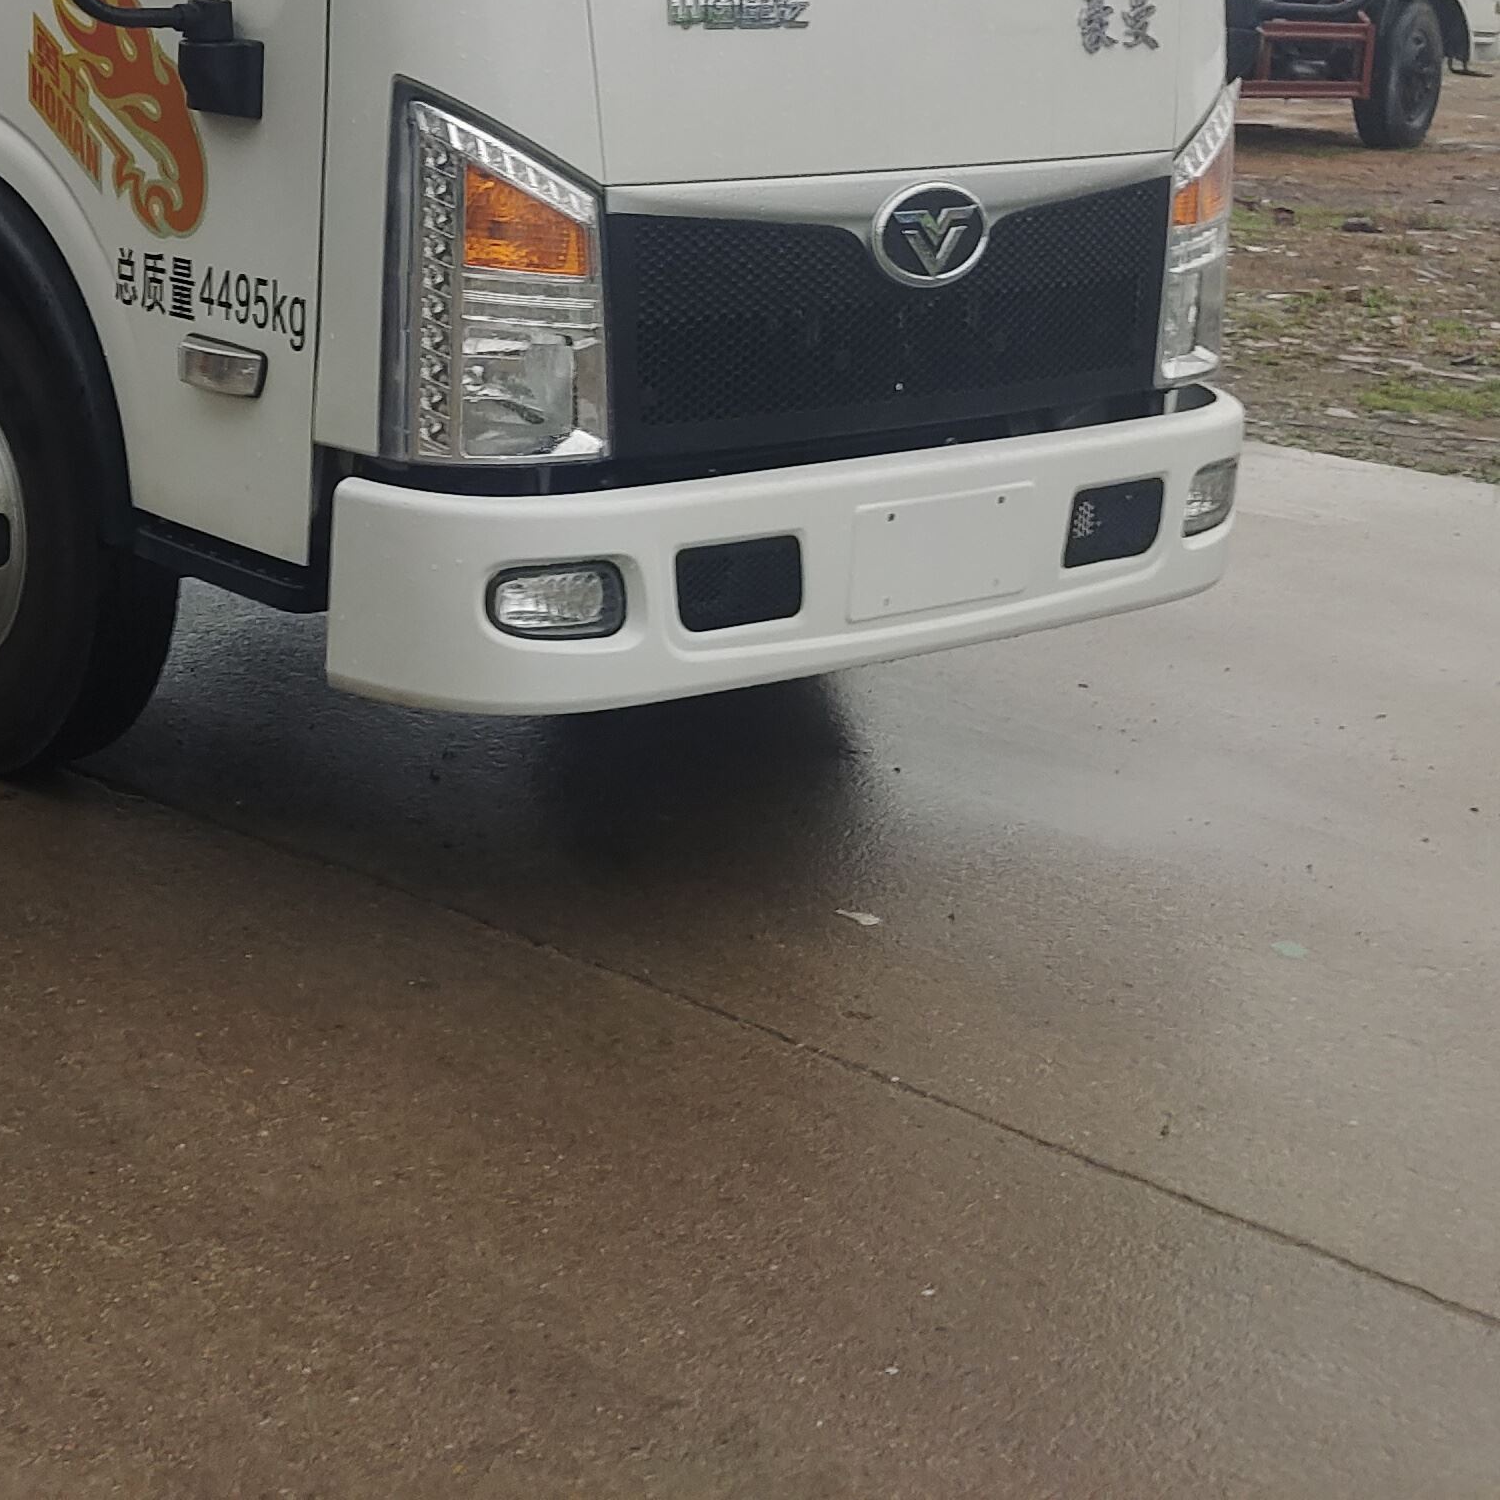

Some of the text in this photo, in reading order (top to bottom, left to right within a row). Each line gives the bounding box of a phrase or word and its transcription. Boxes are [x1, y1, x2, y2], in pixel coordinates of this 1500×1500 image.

[31, 60, 100, 183] HOMAN
[115, 247, 307, 352] 总质量4495kg
